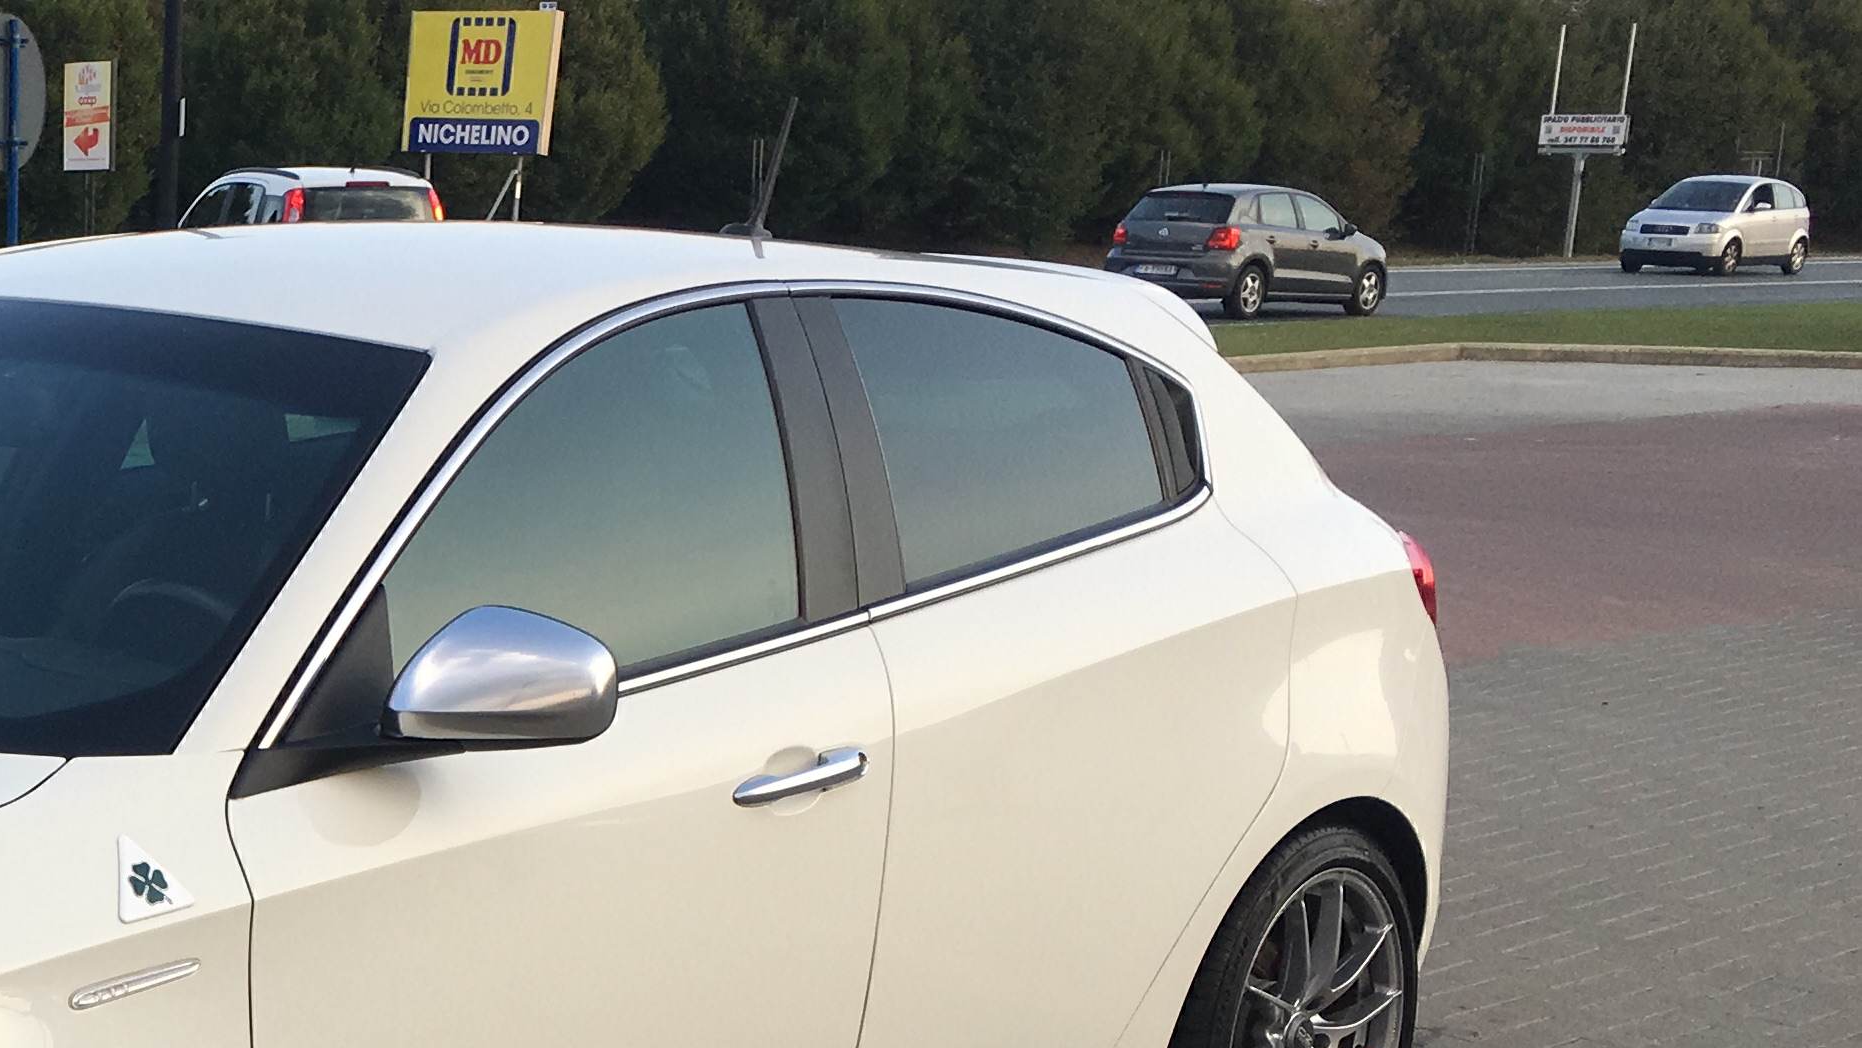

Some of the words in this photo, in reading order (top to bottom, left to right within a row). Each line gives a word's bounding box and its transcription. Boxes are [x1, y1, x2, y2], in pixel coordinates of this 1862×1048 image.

[460, 38, 503, 65] MD
[421, 100, 440, 114] Via
[525, 102, 534, 115] 4
[418, 124, 530, 146] NICHELINO
